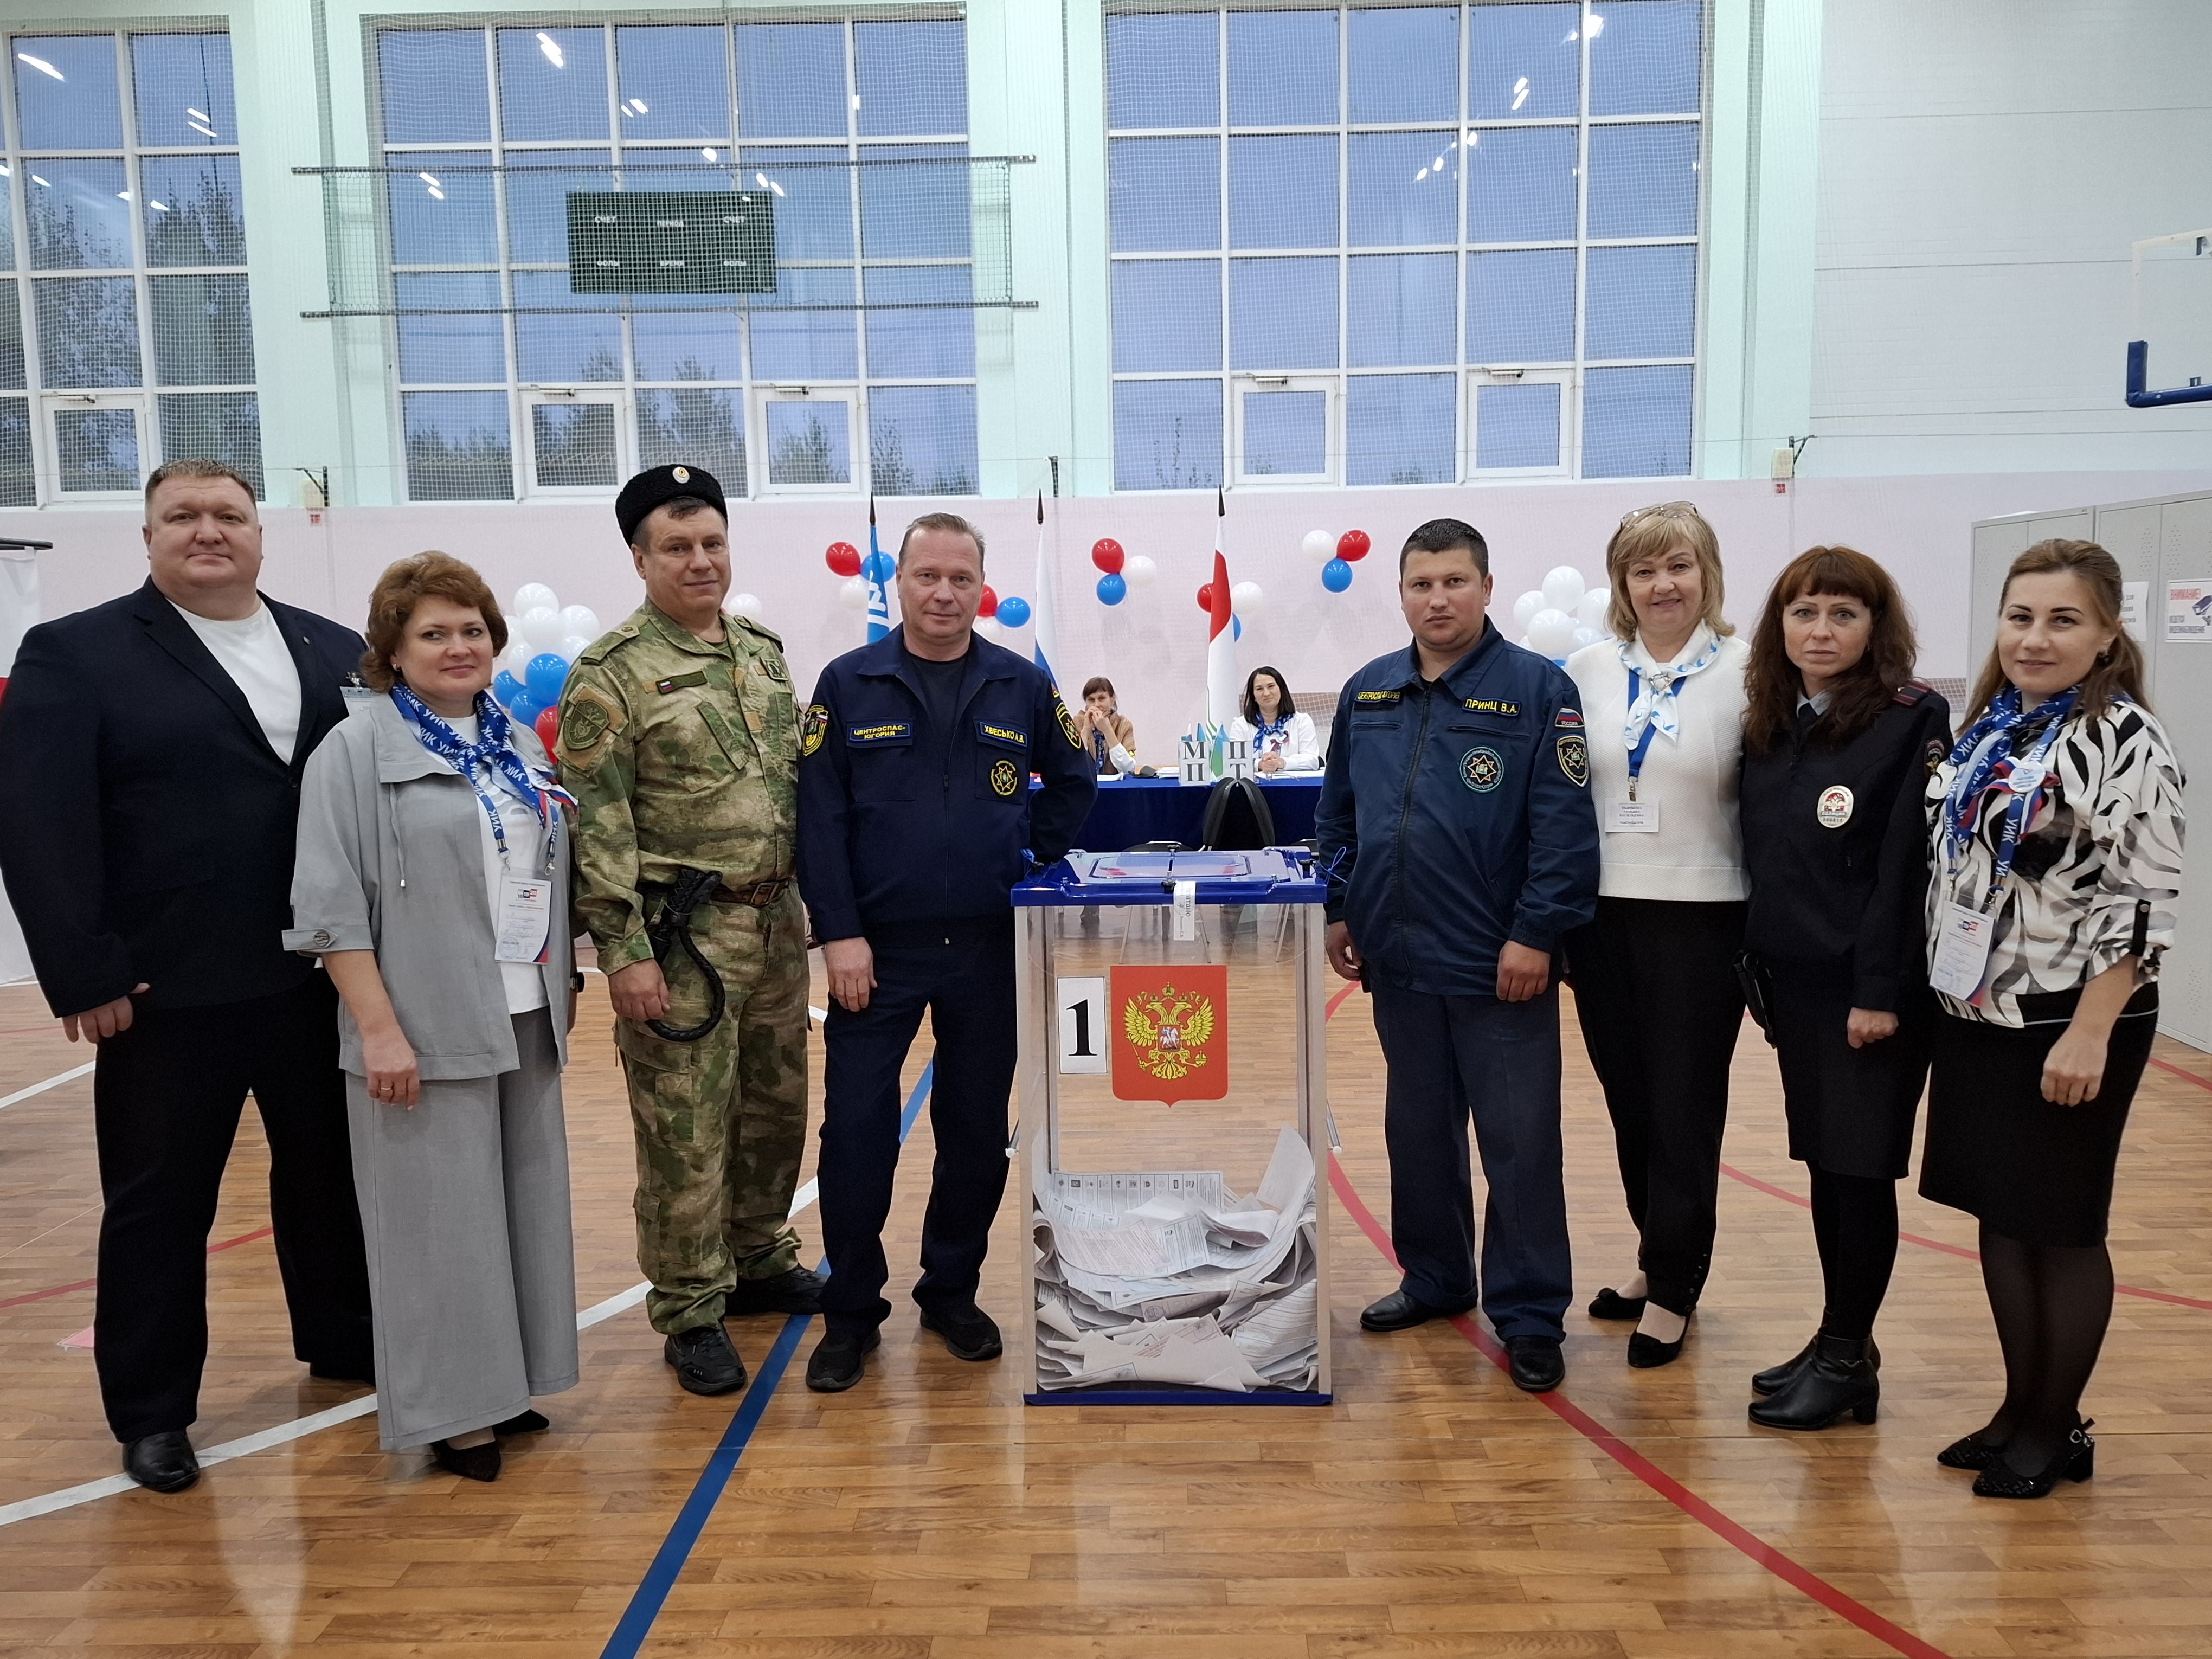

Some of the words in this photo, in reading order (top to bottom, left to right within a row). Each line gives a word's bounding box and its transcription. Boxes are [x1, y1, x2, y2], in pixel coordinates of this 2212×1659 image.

[484, 698, 501, 718] УИК
[1465, 698, 1497, 712] ПРИНЦ
[1501, 703, 1517, 713] В.А.
[853, 725, 906, 736] ЦЕНТРОСПАС-
[1182, 741, 1206, 760] М
[1227, 741, 1248, 760] П
[1956, 732, 1980, 757] УИК
[504, 764, 525, 782] УИК
[1185, 763, 1205, 782] П
[1230, 763, 1246, 781] Т
[1946, 777, 1962, 799] УИК
[488, 808, 502, 832] УИК
[1946, 815, 1954, 840] УИК
[2002, 818, 2019, 844] УИК
[1995, 860, 2010, 878] УИ
[1066, 998, 1099, 1057] 1
